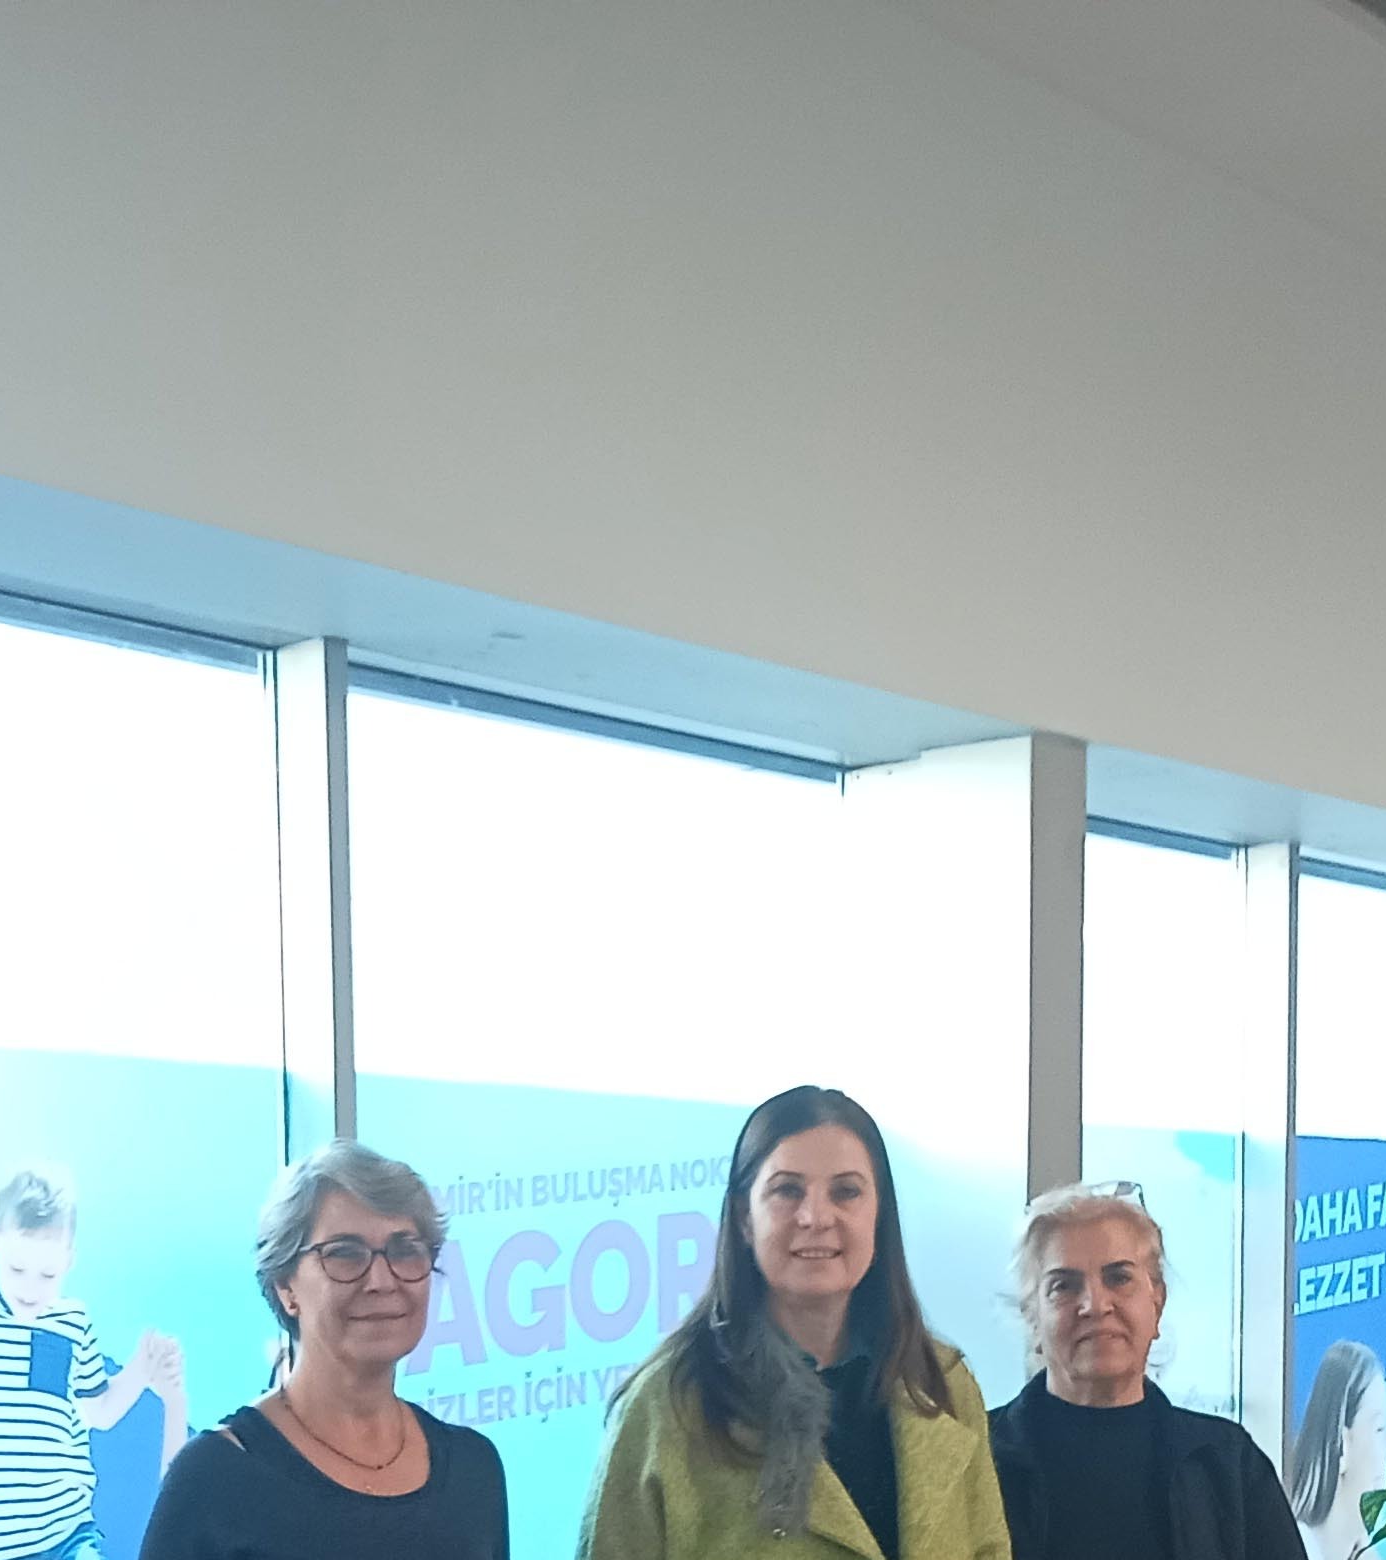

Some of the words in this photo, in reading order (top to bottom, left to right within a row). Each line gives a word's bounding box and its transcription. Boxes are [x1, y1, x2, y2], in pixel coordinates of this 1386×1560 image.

[532, 1164, 664, 1207] BULUŞMA
[671, 1156, 733, 1190] NOK
[1294, 1253, 1386, 1316] EZZET
[417, 1385, 517, 1426] İZLER
[525, 1367, 587, 1423] İÇİN
